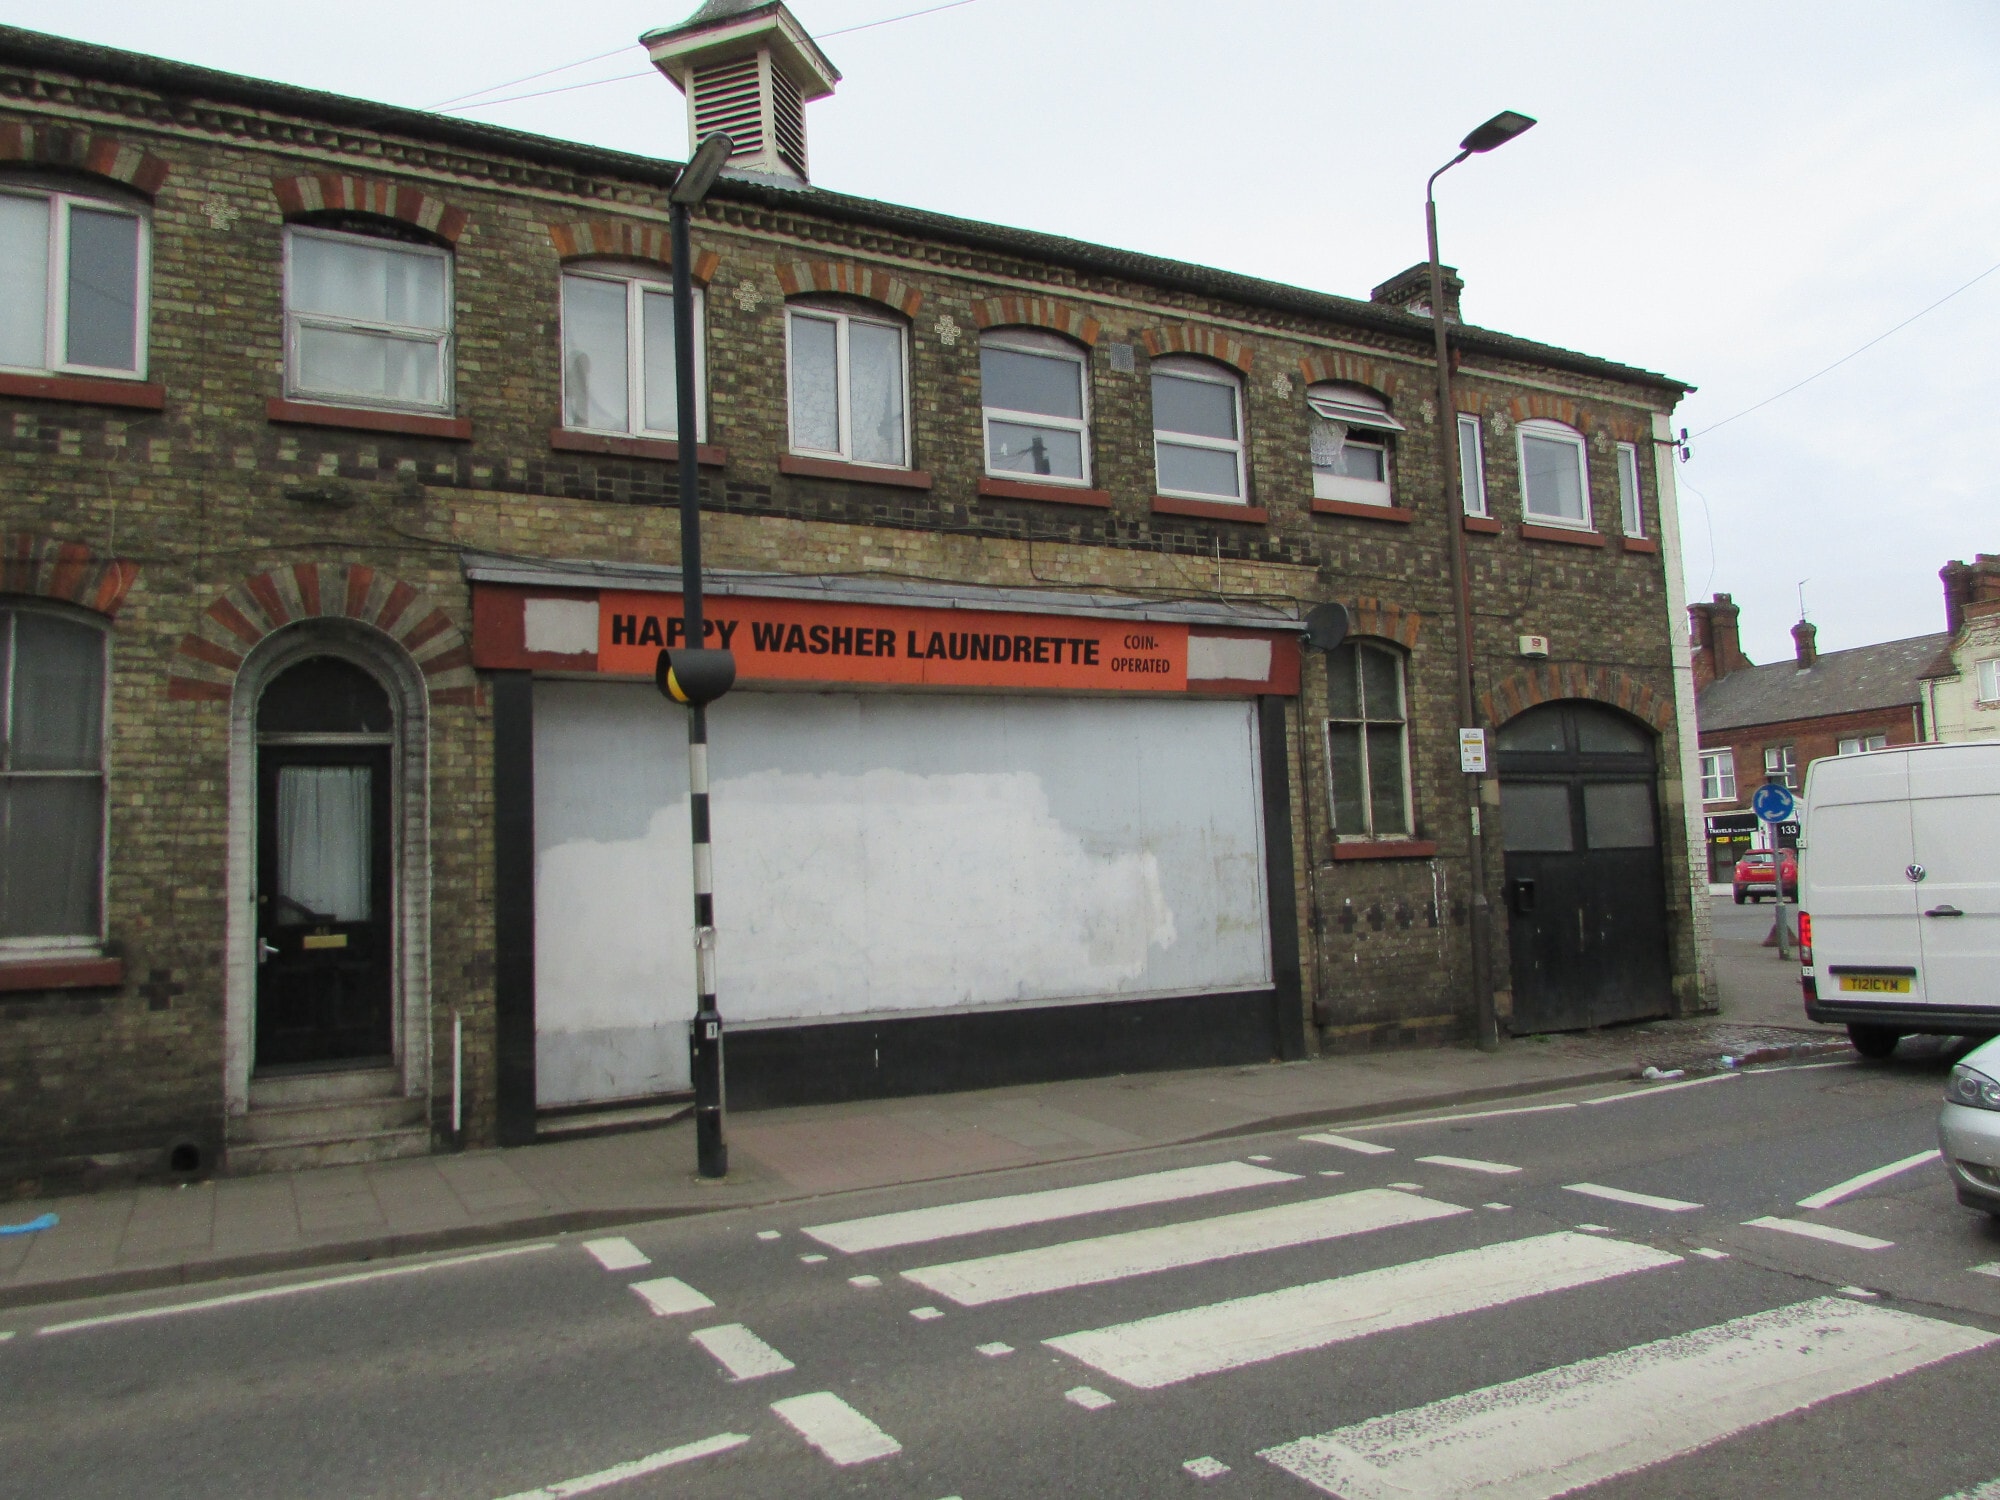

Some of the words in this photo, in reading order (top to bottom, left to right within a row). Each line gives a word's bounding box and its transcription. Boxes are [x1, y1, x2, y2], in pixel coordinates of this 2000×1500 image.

[752, 622, 896, 657] WASHER
[907, 630, 1099, 666] LAUNDRETTE
[1124, 634, 1159, 651] COIN-
[1111, 657, 1170, 674] OPERATED
[1781, 825, 1796, 835] 133
